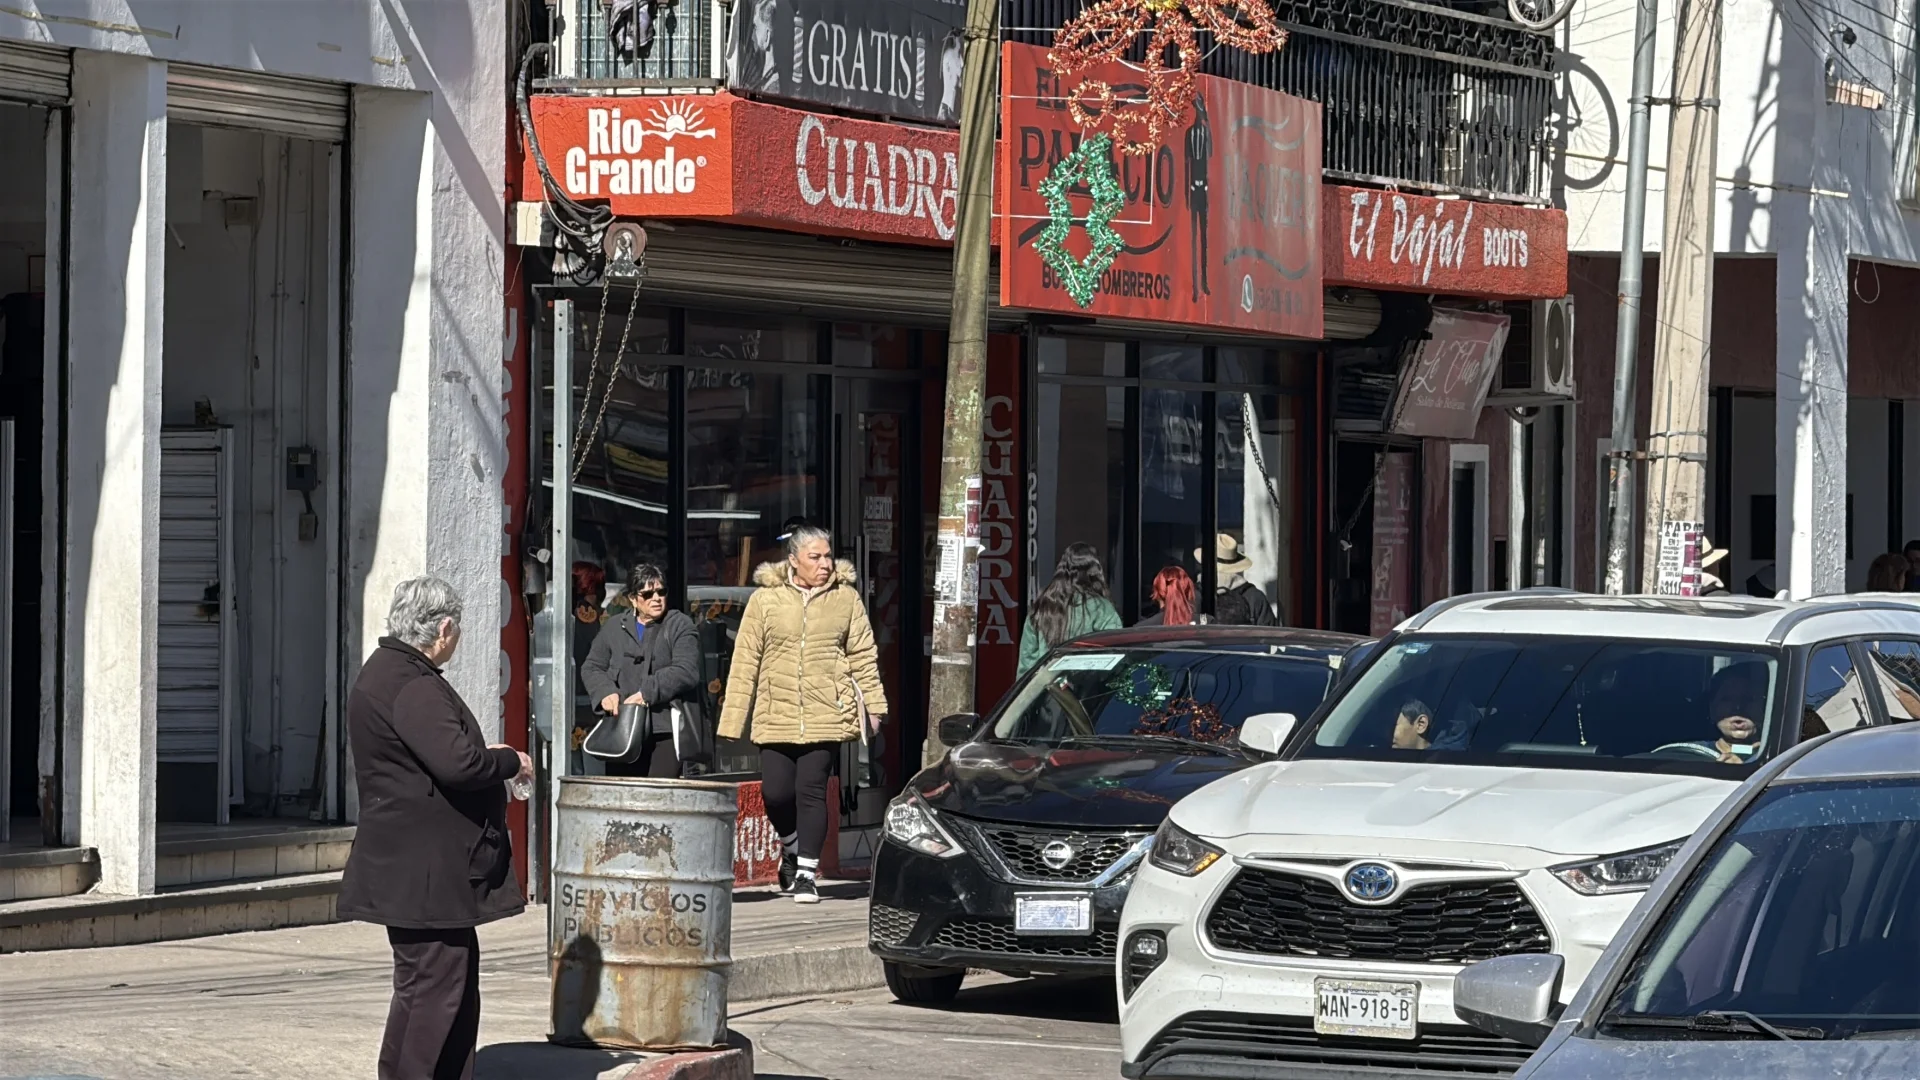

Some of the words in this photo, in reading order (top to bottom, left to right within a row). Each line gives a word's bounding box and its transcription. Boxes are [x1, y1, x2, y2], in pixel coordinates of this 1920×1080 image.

[808, 20, 912, 99] GRATIS
[588, 107, 642, 155] Rio
[1019, 126, 1176, 208] PALCIO
[1349, 191, 1382, 262] El
[1483, 227, 1528, 267] BOOTS
[979, 395, 1018, 645] CUADRA
[1319, 994, 1409, 1022] WAN-918-B
